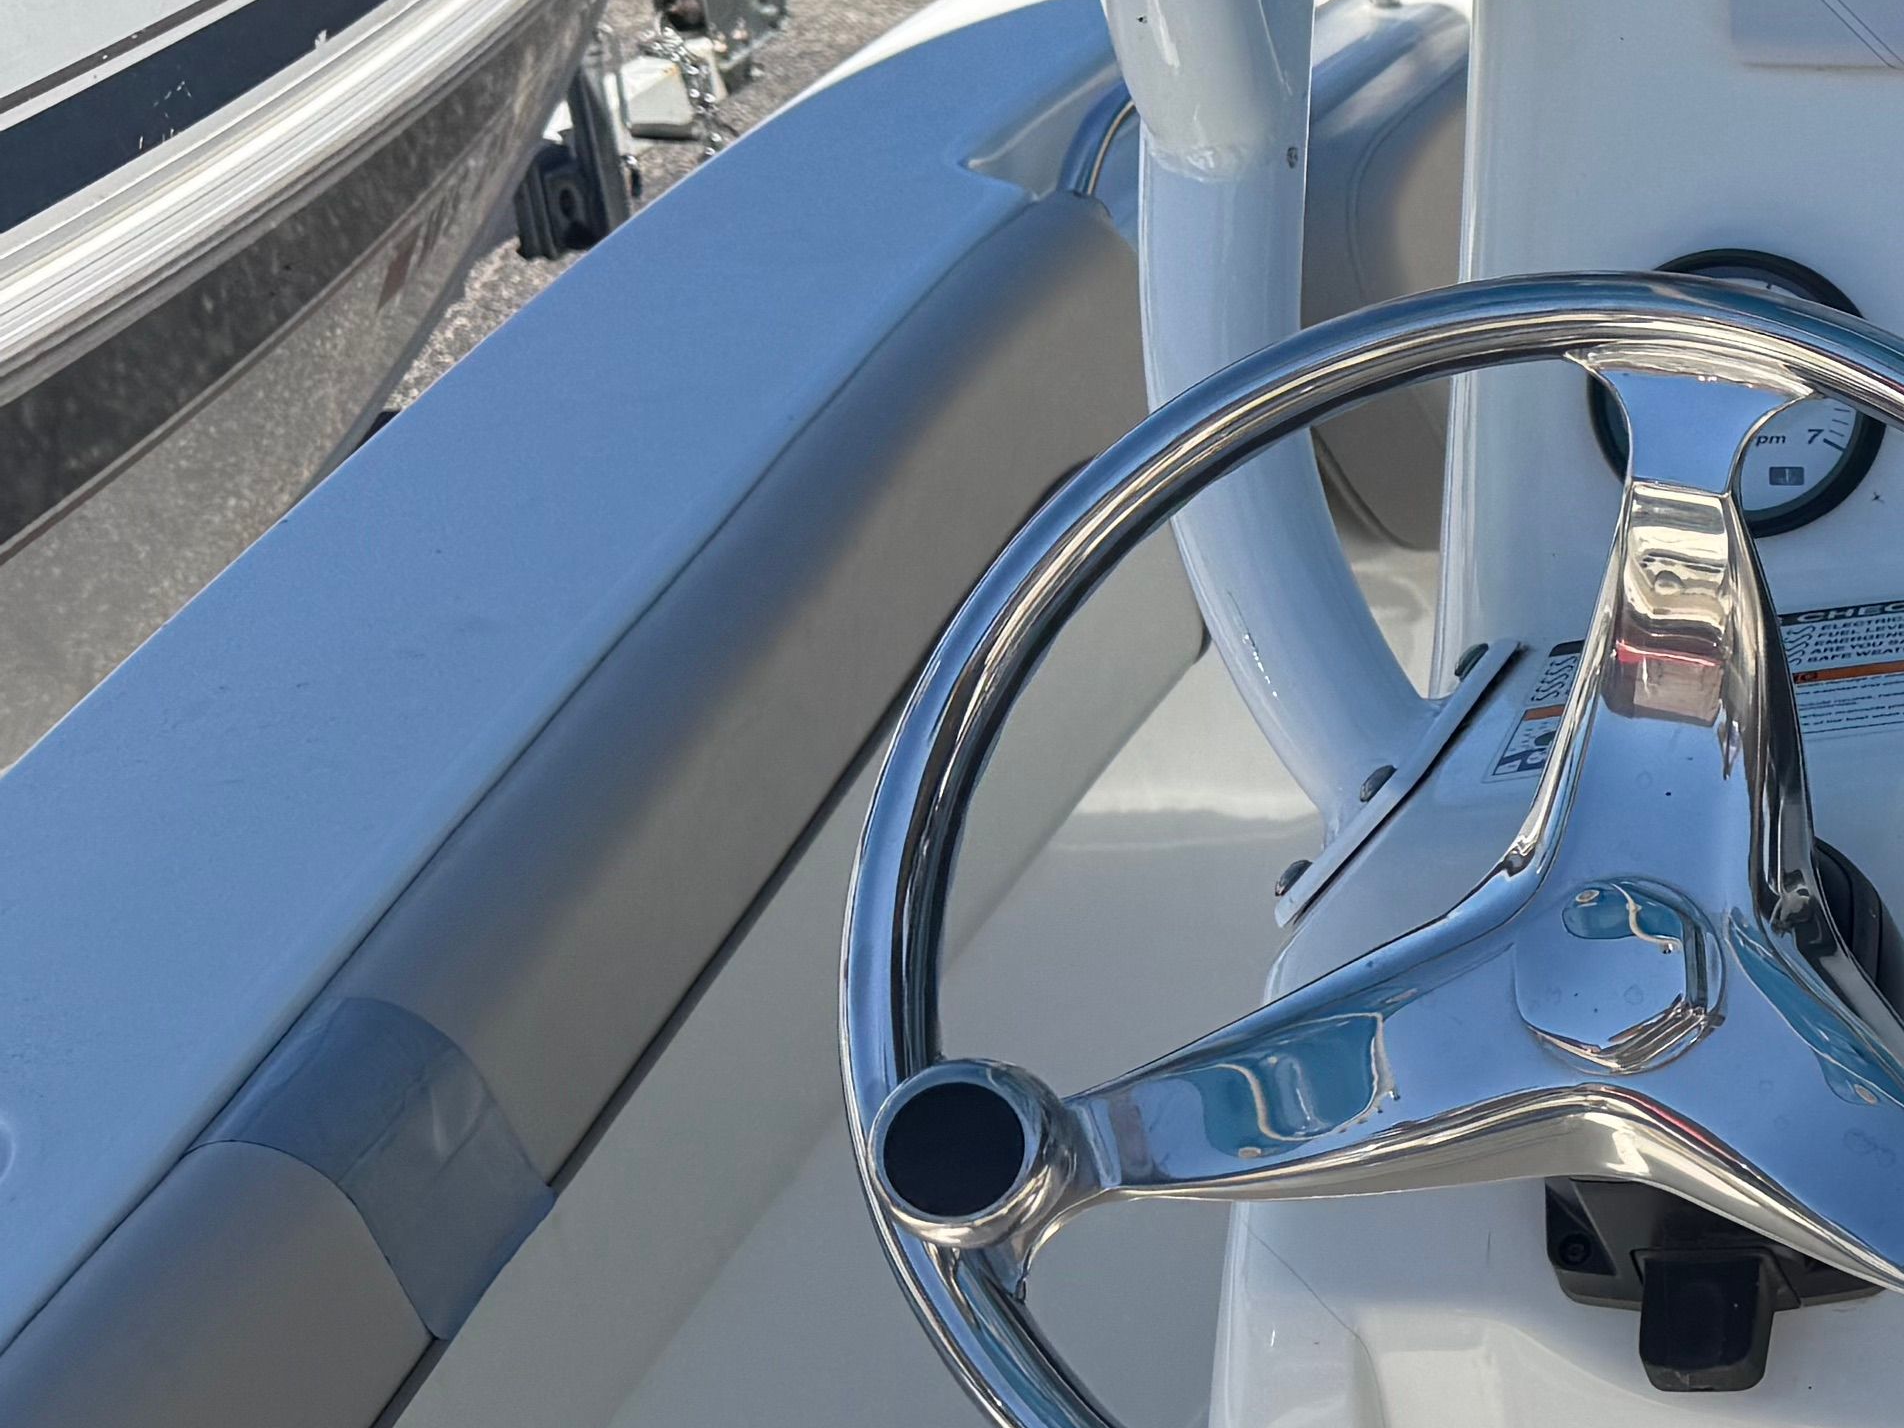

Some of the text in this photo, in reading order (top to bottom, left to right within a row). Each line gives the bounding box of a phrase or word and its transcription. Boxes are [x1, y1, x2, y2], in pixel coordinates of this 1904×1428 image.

[1755, 433, 1786, 447] pm
[1807, 428, 1825, 445] 7
[1818, 629, 1856, 638] FUEL
[1809, 645, 1846, 655] ARE
[1850, 640, 1884, 650] YOU
[1807, 652, 1852, 663] SAFE
